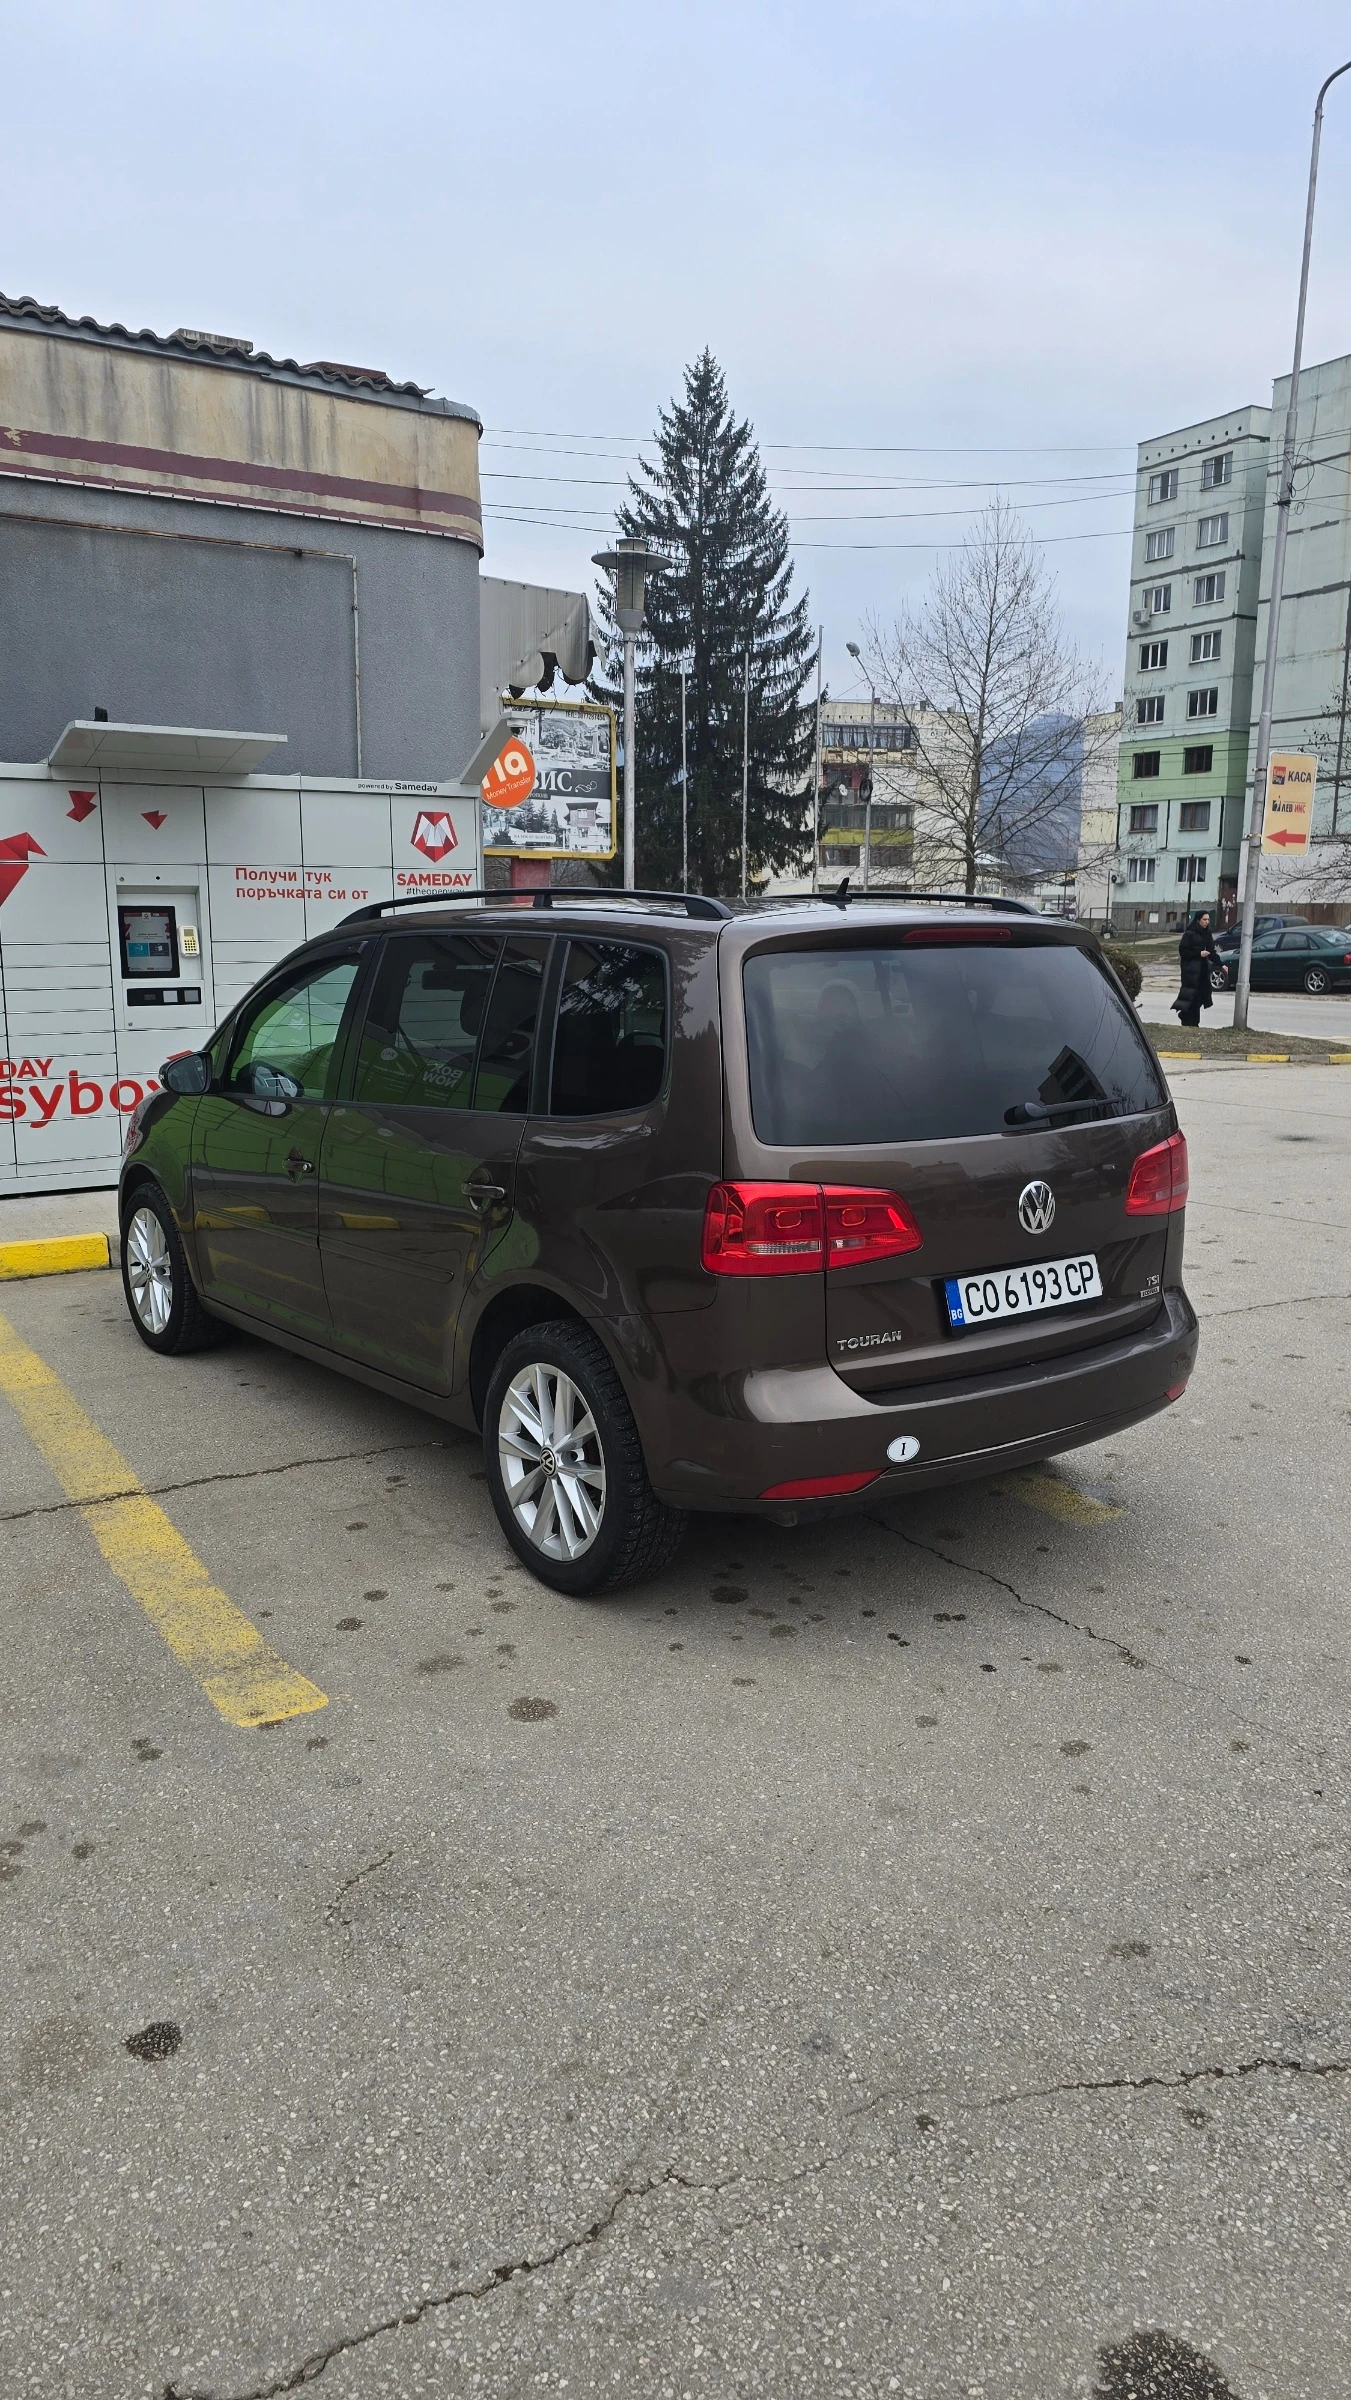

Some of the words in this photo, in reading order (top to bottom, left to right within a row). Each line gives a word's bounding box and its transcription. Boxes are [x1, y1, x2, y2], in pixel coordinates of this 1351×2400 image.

[1288, 770, 1311, 783] КАСА
[394, 782, 438, 793] Sameday
[486, 786, 507, 800] Money
[506, 776, 531, 791] Transfer
[235, 867, 297, 884] Получи
[305, 871, 332, 885] тук
[396, 873, 473, 886] SAMEDAY
[236, 887, 322, 901] поръчката
[327, 889, 346, 900] си
[351, 889, 369, 900] от
[0, 1058, 53, 1080] DAY
[0, 1069, 161, 1129] sybo
[1146, 1274, 1160, 1286] TSI
[951, 1309, 963, 1320] BG
[837, 1330, 902, 1351] TOURAN
